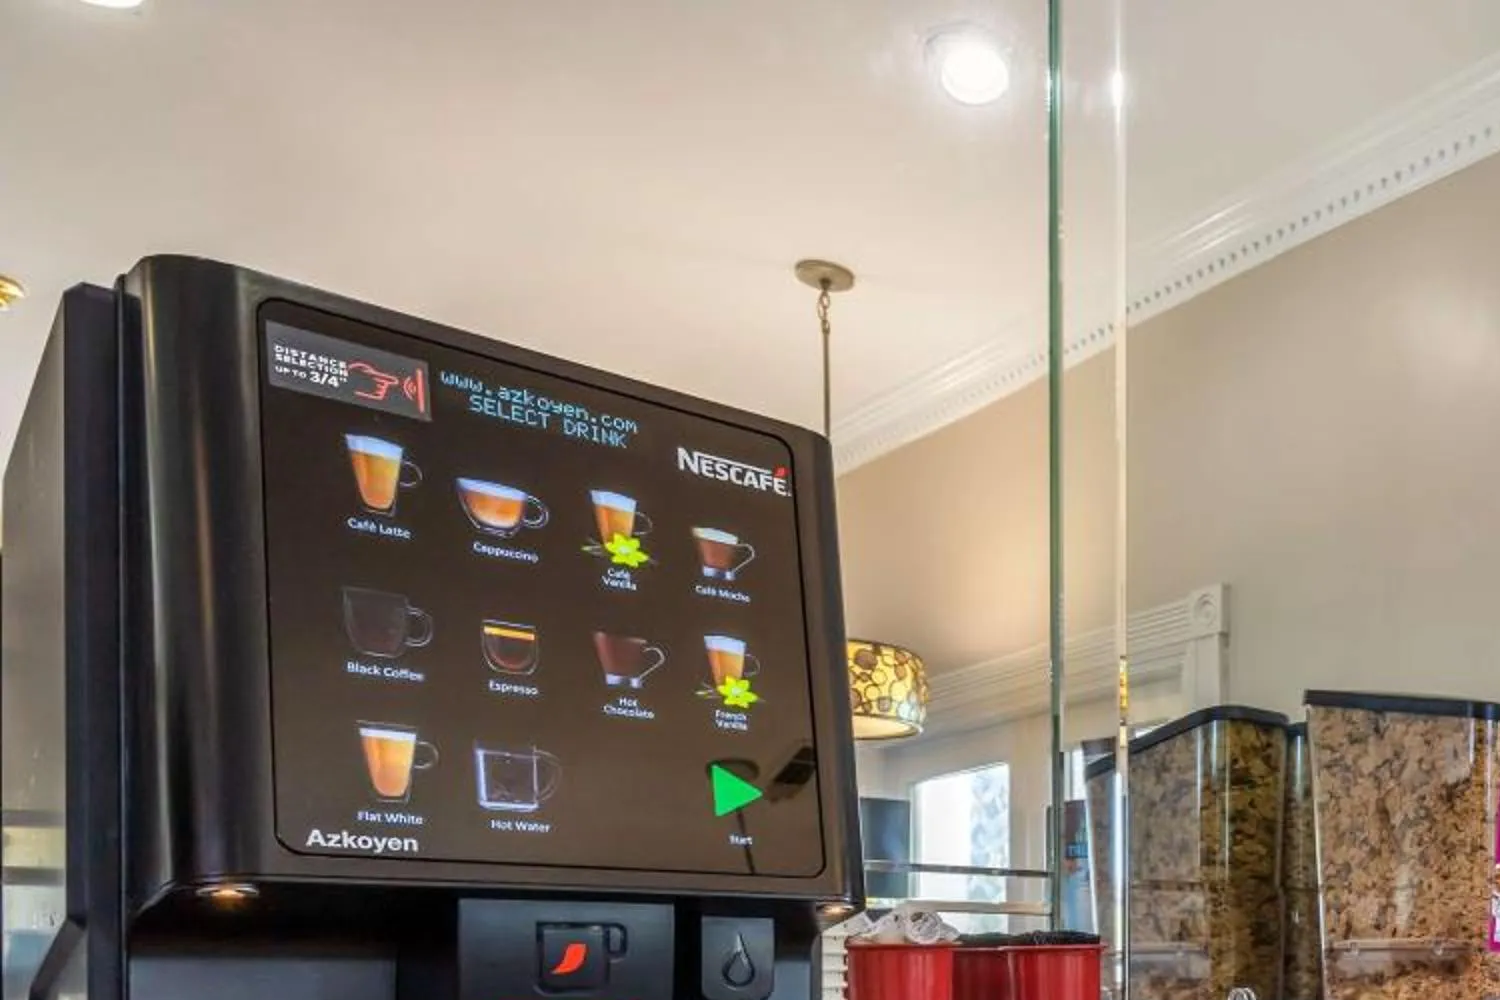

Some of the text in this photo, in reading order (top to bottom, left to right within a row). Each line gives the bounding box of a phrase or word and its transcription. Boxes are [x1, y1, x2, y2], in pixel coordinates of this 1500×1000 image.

[274, 345, 348, 369] DISTANCE
[275, 354, 349, 378] SELECTION
[275, 366, 290, 375] UP
[291, 370, 307, 379] TO
[440, 370, 639, 435] www.azkoyen.com
[469, 395, 627, 448] SELECT DRINK
[677, 446, 789, 497] NESCAFÉ
[347, 517, 412, 540] Café Latte
[473, 541, 539, 564] Cappuccino
[347, 661, 425, 682] Black Coffee
[488, 679, 539, 696] Espresso
[603, 704, 655, 719] Chocolate
[619, 697, 638, 707] Hot
[357, 811, 424, 826] Flat White
[490, 819, 551, 834] Hot Water
[306, 829, 419, 854] Azkoyen
